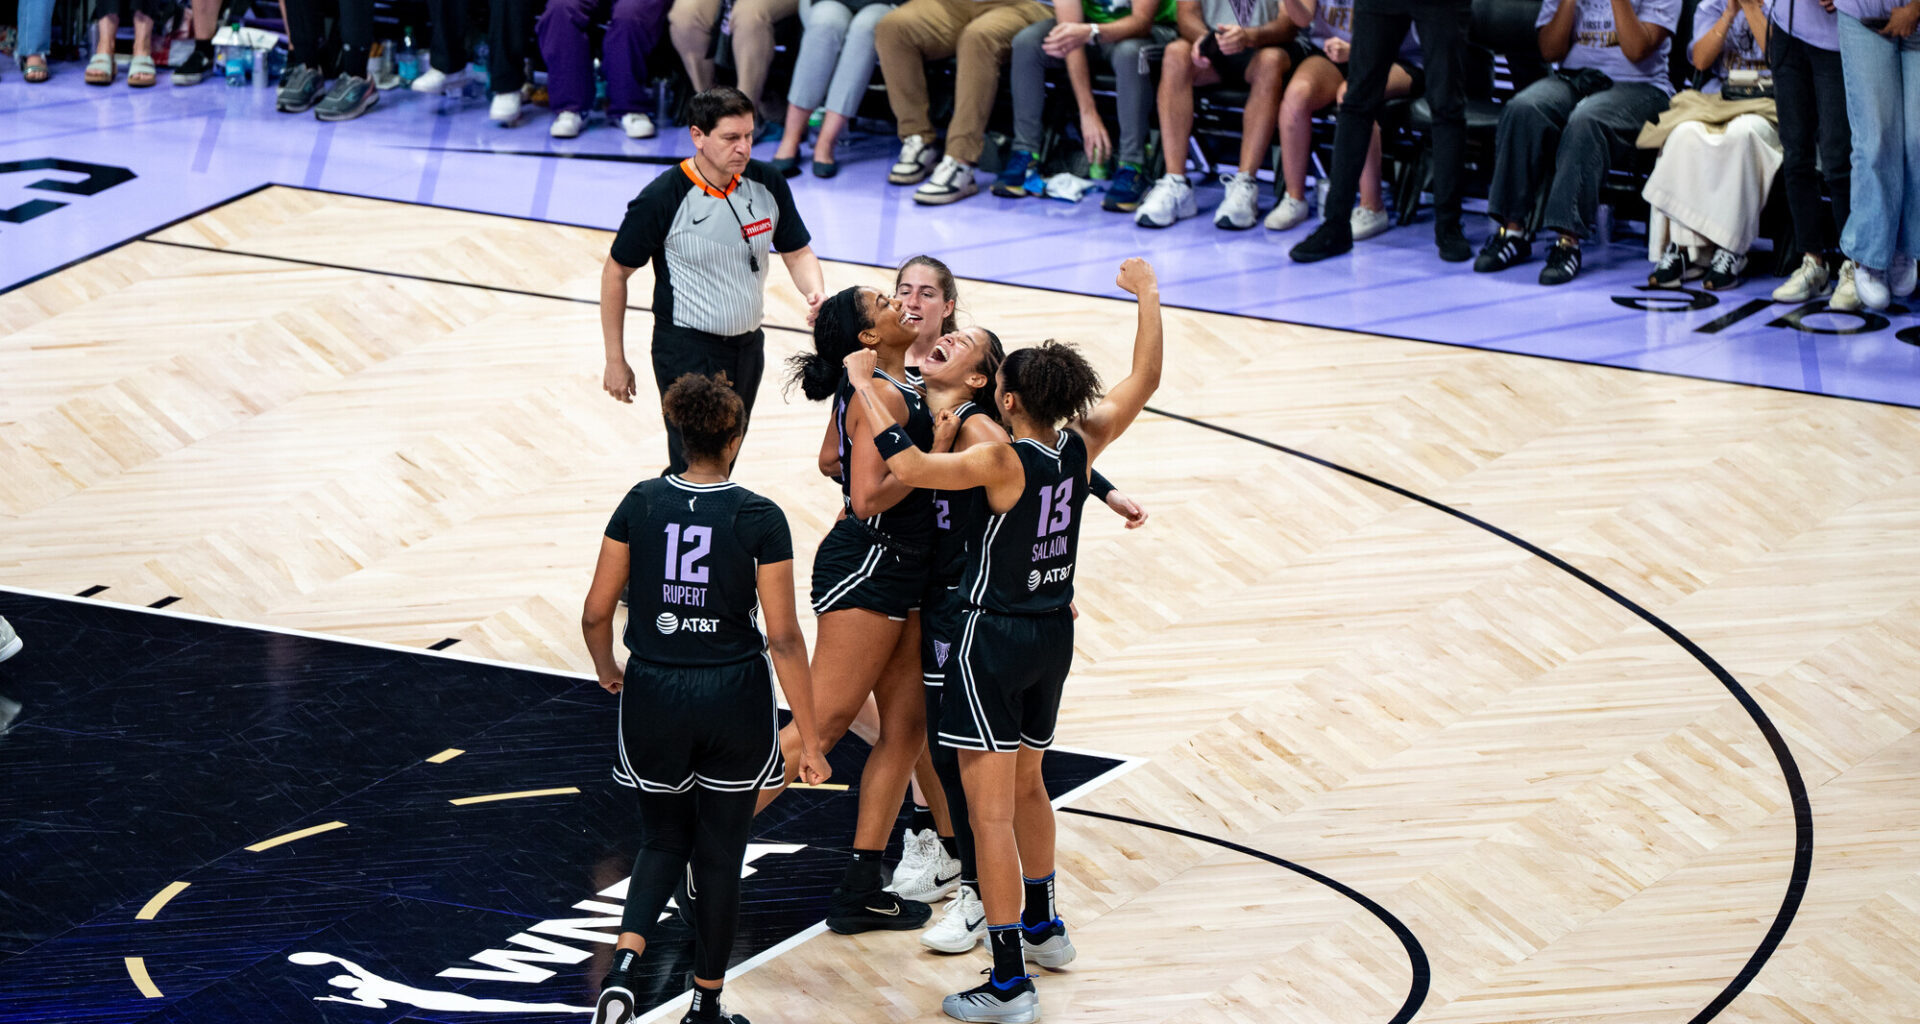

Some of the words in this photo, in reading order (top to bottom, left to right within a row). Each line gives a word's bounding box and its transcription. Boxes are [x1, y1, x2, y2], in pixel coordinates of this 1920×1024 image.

[1036, 476, 1074, 538] 13
[663, 522, 713, 584] 12
[1042, 563, 1073, 585] AT&T
[662, 583, 708, 608] RUPERT
[681, 618, 720, 633] AT&T
